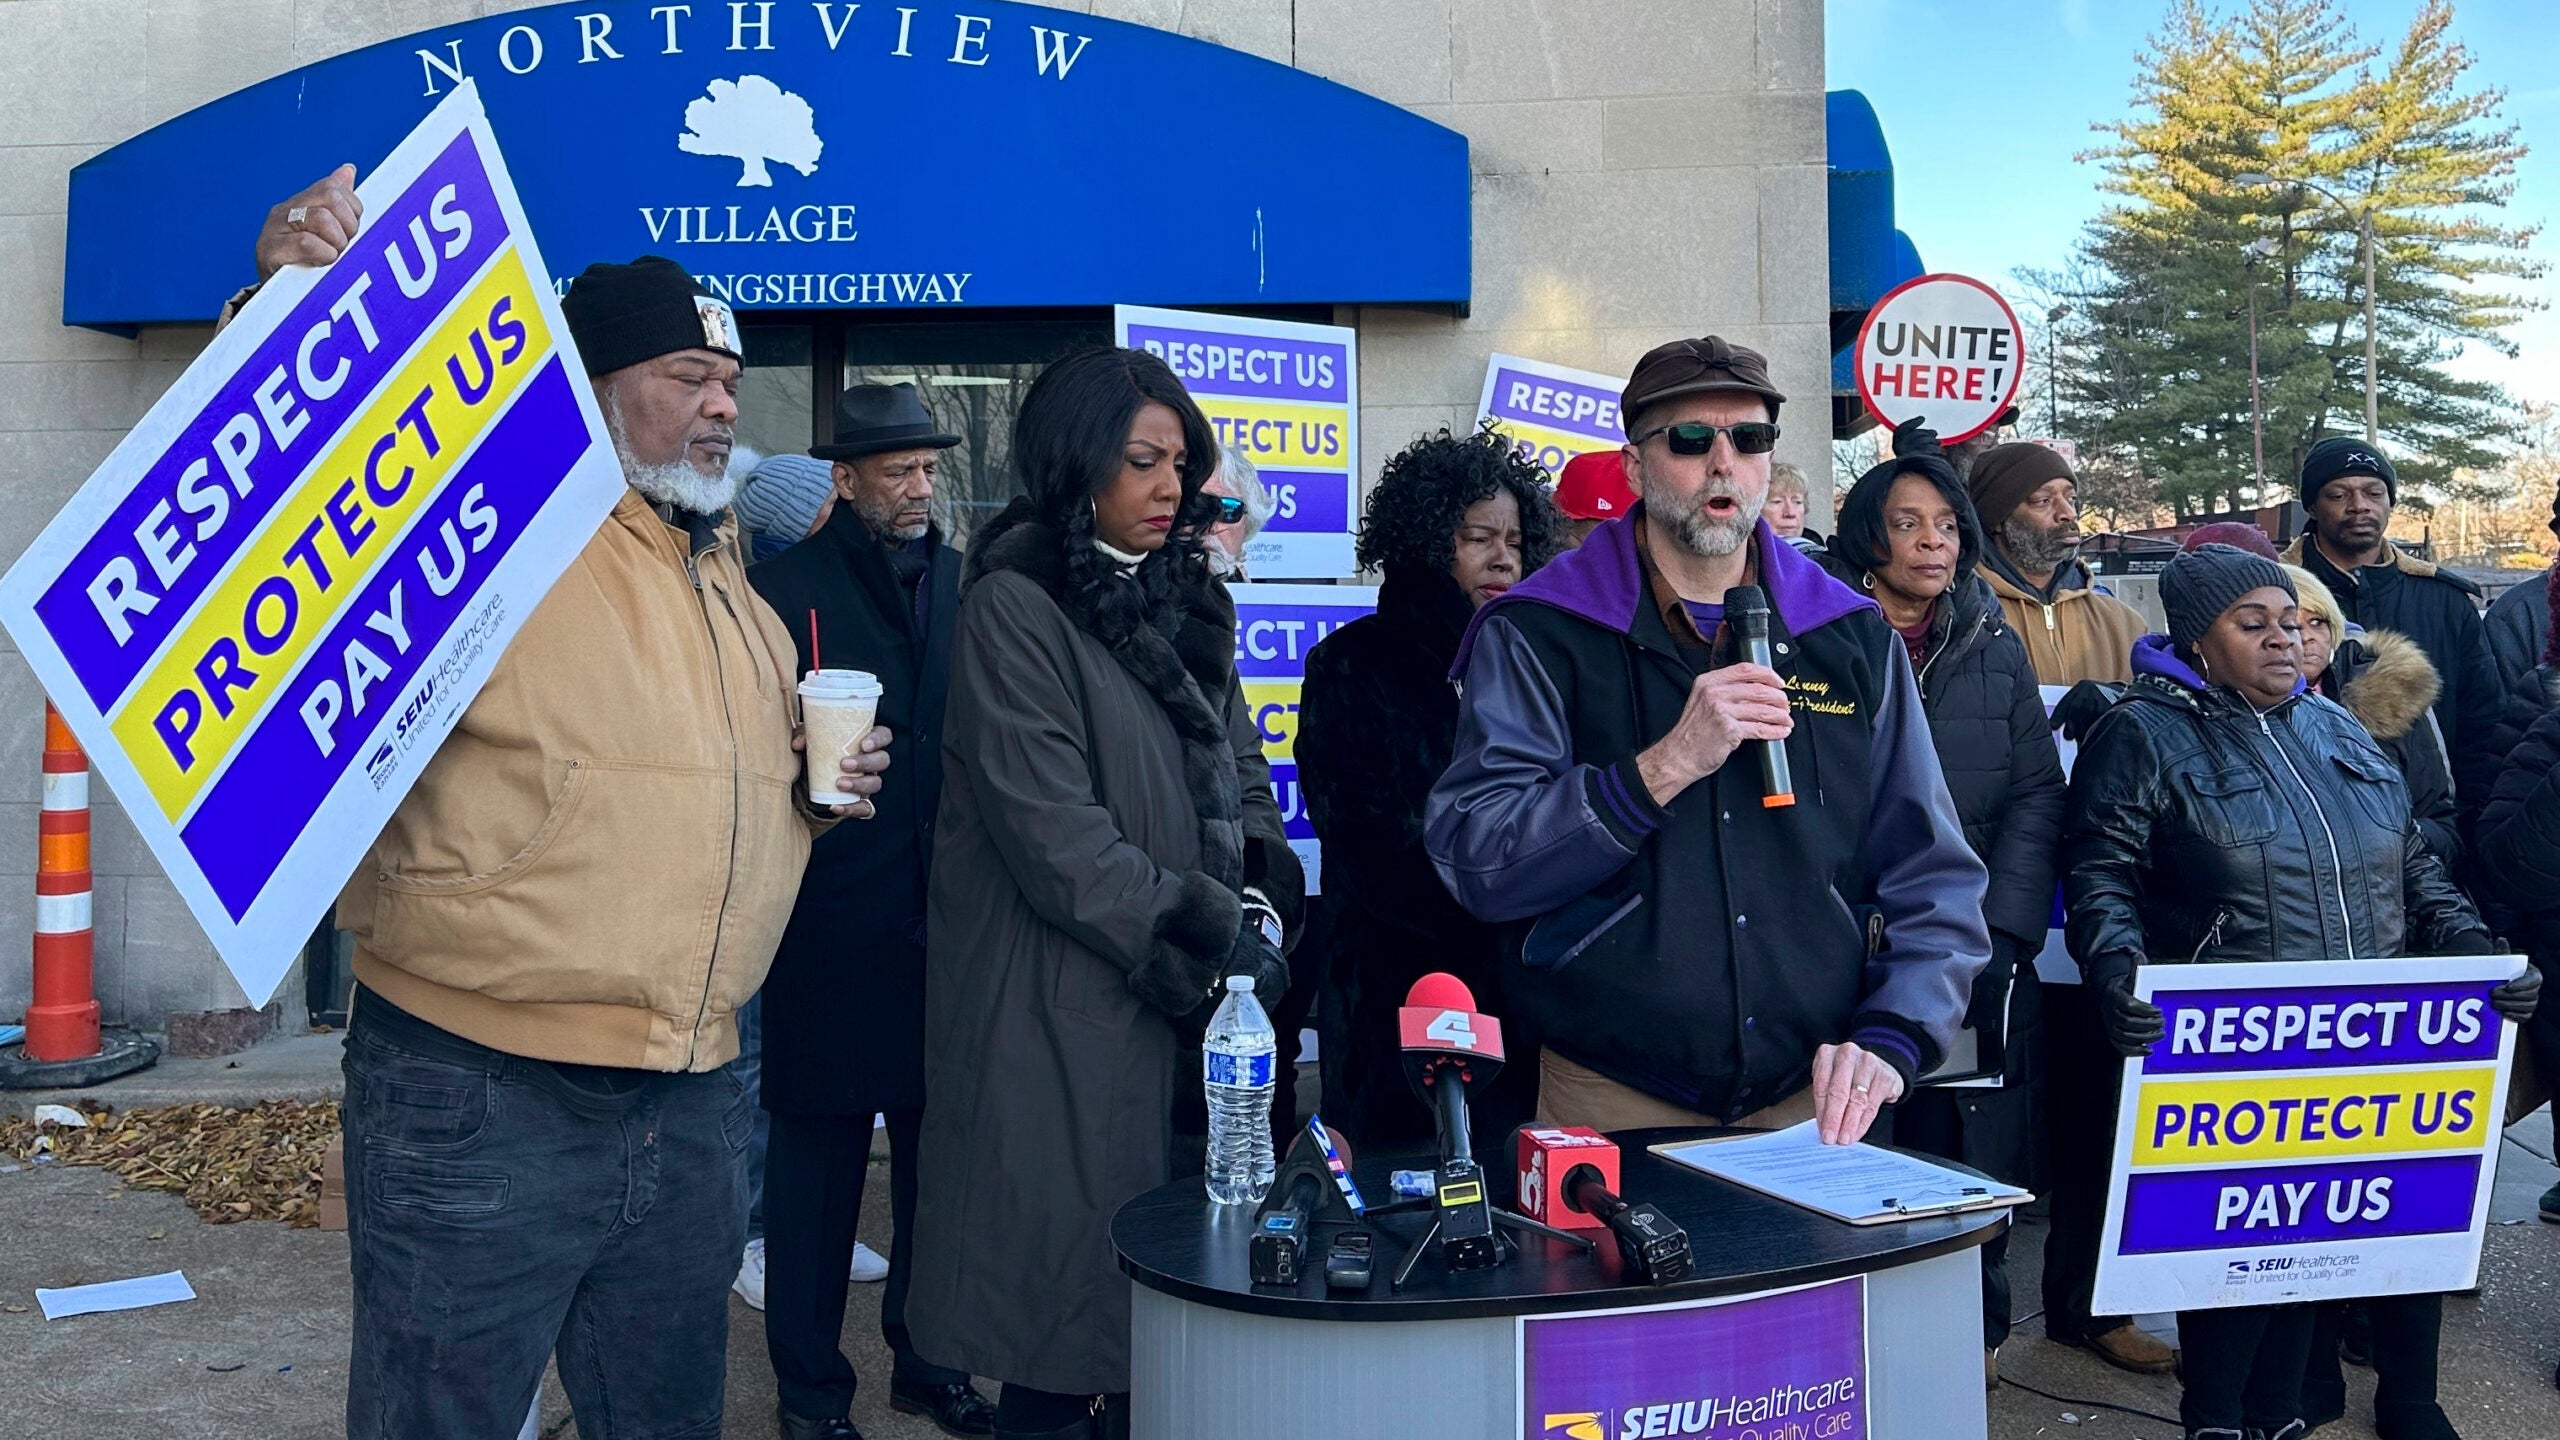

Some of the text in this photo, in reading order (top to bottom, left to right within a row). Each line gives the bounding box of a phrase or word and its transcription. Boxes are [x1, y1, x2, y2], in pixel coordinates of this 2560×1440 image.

[415, 2, 1092, 96] NORTHVIEW
[638, 205, 858, 244] VILLAGE
[1876, 322, 2011, 361] UNITE
[1295, 352, 1335, 389] US
[1873, 362, 2003, 403] HERE!
[86, 184, 474, 647] RESPECT US
[1507, 381, 1625, 431] RESPE
[1212, 417, 1339, 456] TECT US
[152, 296, 527, 774] PROTECT US
[299, 483, 499, 758] PAY US
[402, 707, 437, 751] United
[434, 683, 451, 708] for
[449, 640, 485, 685] Quality
[482, 609, 506, 640] Care
[1426, 1010, 1477, 1049] 4
[2171, 998, 2483, 1054] RESPECT US
[2152, 1090, 2476, 1149] PROTECT US
[2214, 1176, 2393, 1231] PAY US
[2253, 1267, 2357, 1284] United for Quality Care
[1814, 1411, 1852, 1439] Care
